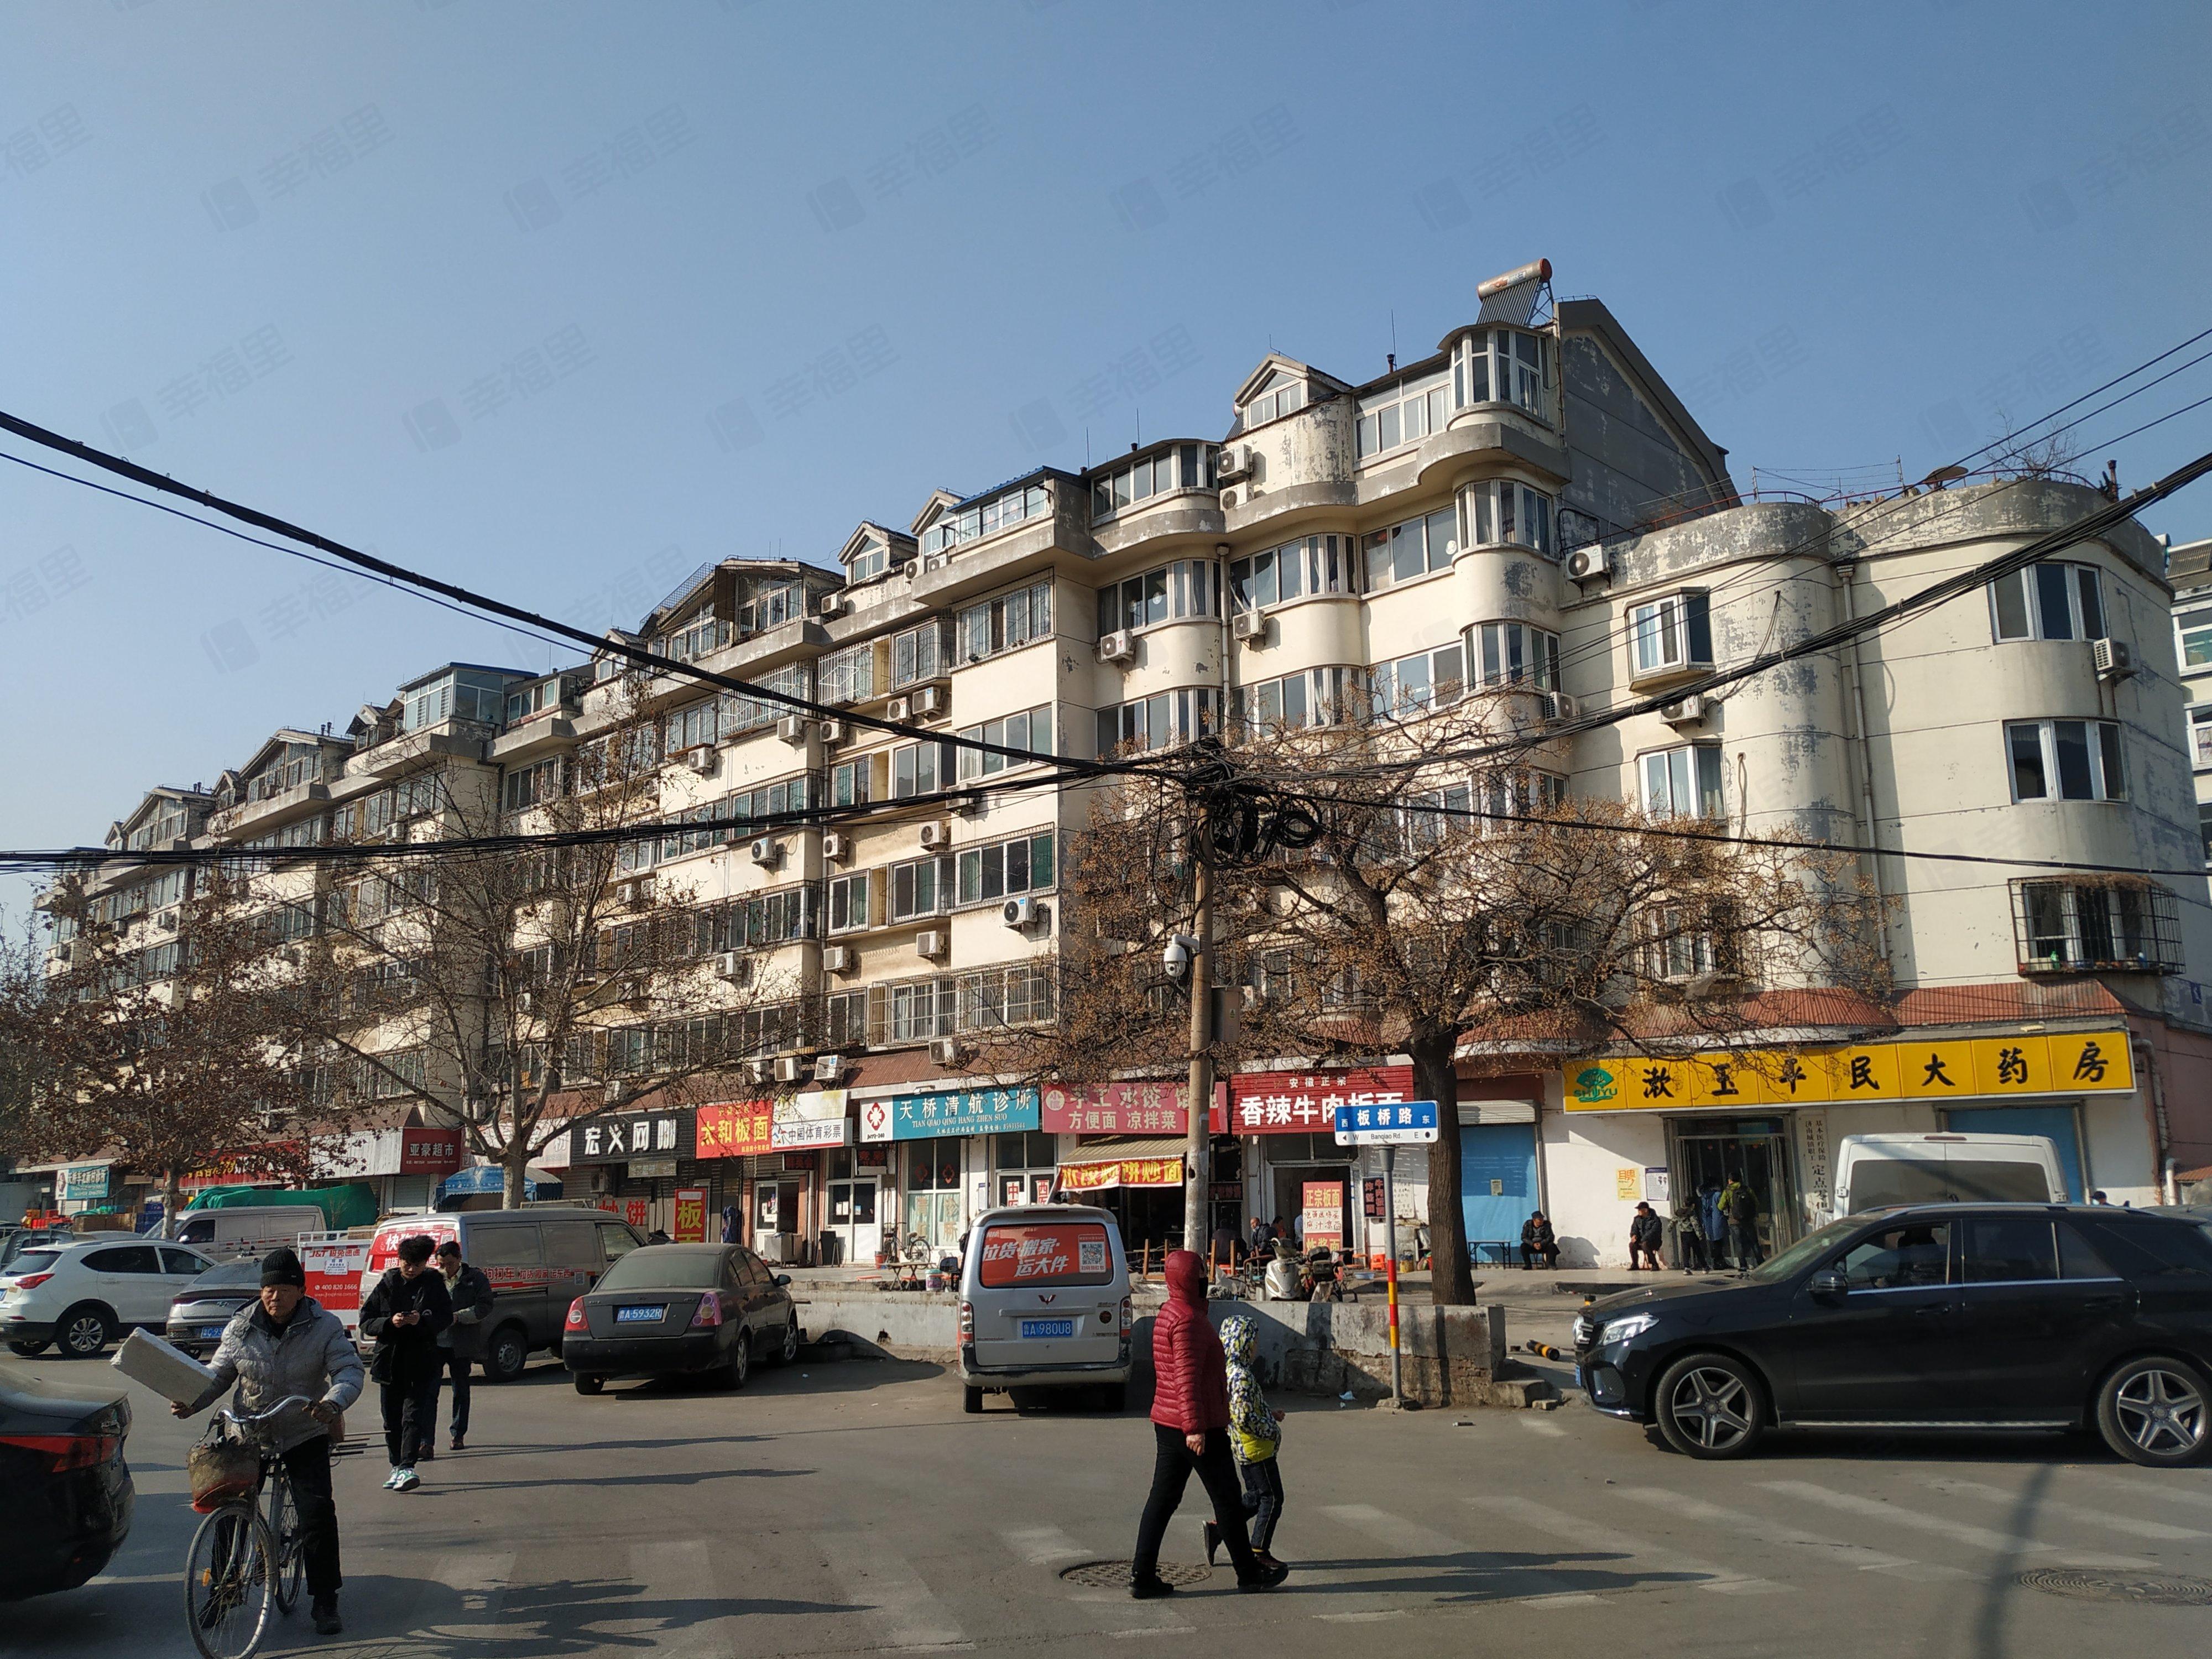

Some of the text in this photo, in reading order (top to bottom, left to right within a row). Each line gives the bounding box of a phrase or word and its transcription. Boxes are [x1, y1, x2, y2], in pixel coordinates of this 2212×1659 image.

[1642, 1042, 2108, 1098] 漱玉平民大药房
[899, 1089, 1030, 1120] 天桥清航诊所
[1119, 1086, 1162, 1109] 水饺
[912, 1113, 1008, 1128] TIAN QIAO QING HANG ZHEN SUO
[1068, 1110, 1177, 1130] 方便面 凉拌菜
[1341, 1107, 1430, 1128] 西 板桥路 东
[585, 1119, 677, 1155] 宏义网咖
[700, 1115, 769, 1146] 太和板面
[788, 1124, 842, 1142] 中国体育彩票
[409, 1142, 455, 1157] 亚豪超市
[1618, 1169, 1635, 1187] 聘
[1306, 1188, 1340, 1208] 正宗板面
[309, 1250, 328, 1258] J&T
[1014, 1255, 1070, 1278] 运大件
